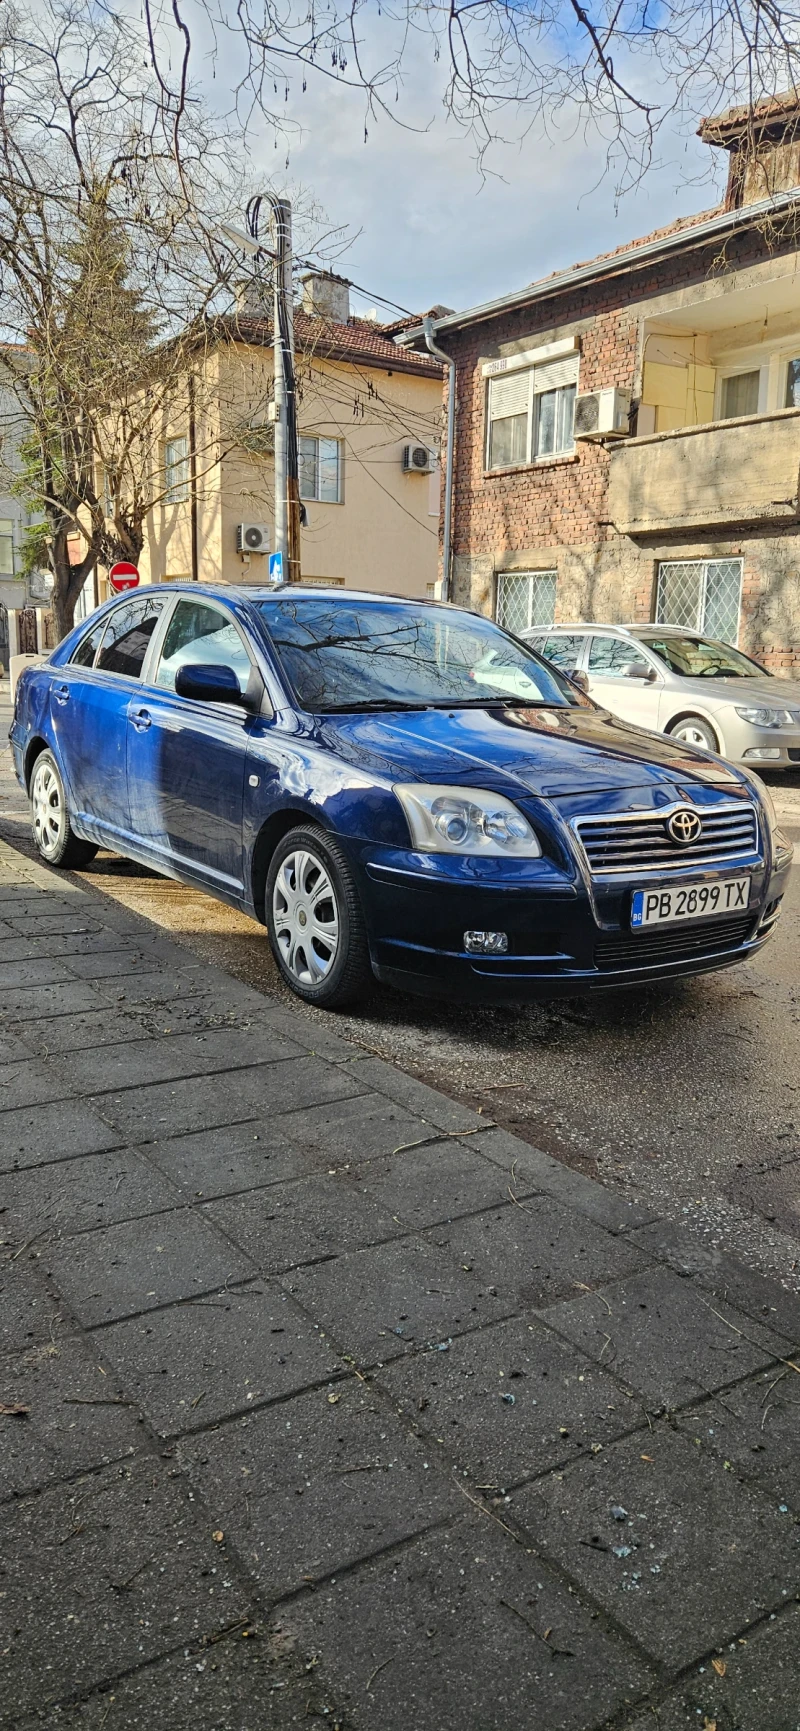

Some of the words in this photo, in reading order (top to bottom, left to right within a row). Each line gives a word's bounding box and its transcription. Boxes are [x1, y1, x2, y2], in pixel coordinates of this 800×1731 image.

[645, 893, 672, 920] PB
[674, 886, 720, 916] 2899
[724, 881, 747, 908] TX
[633, 913, 642, 921] BG
